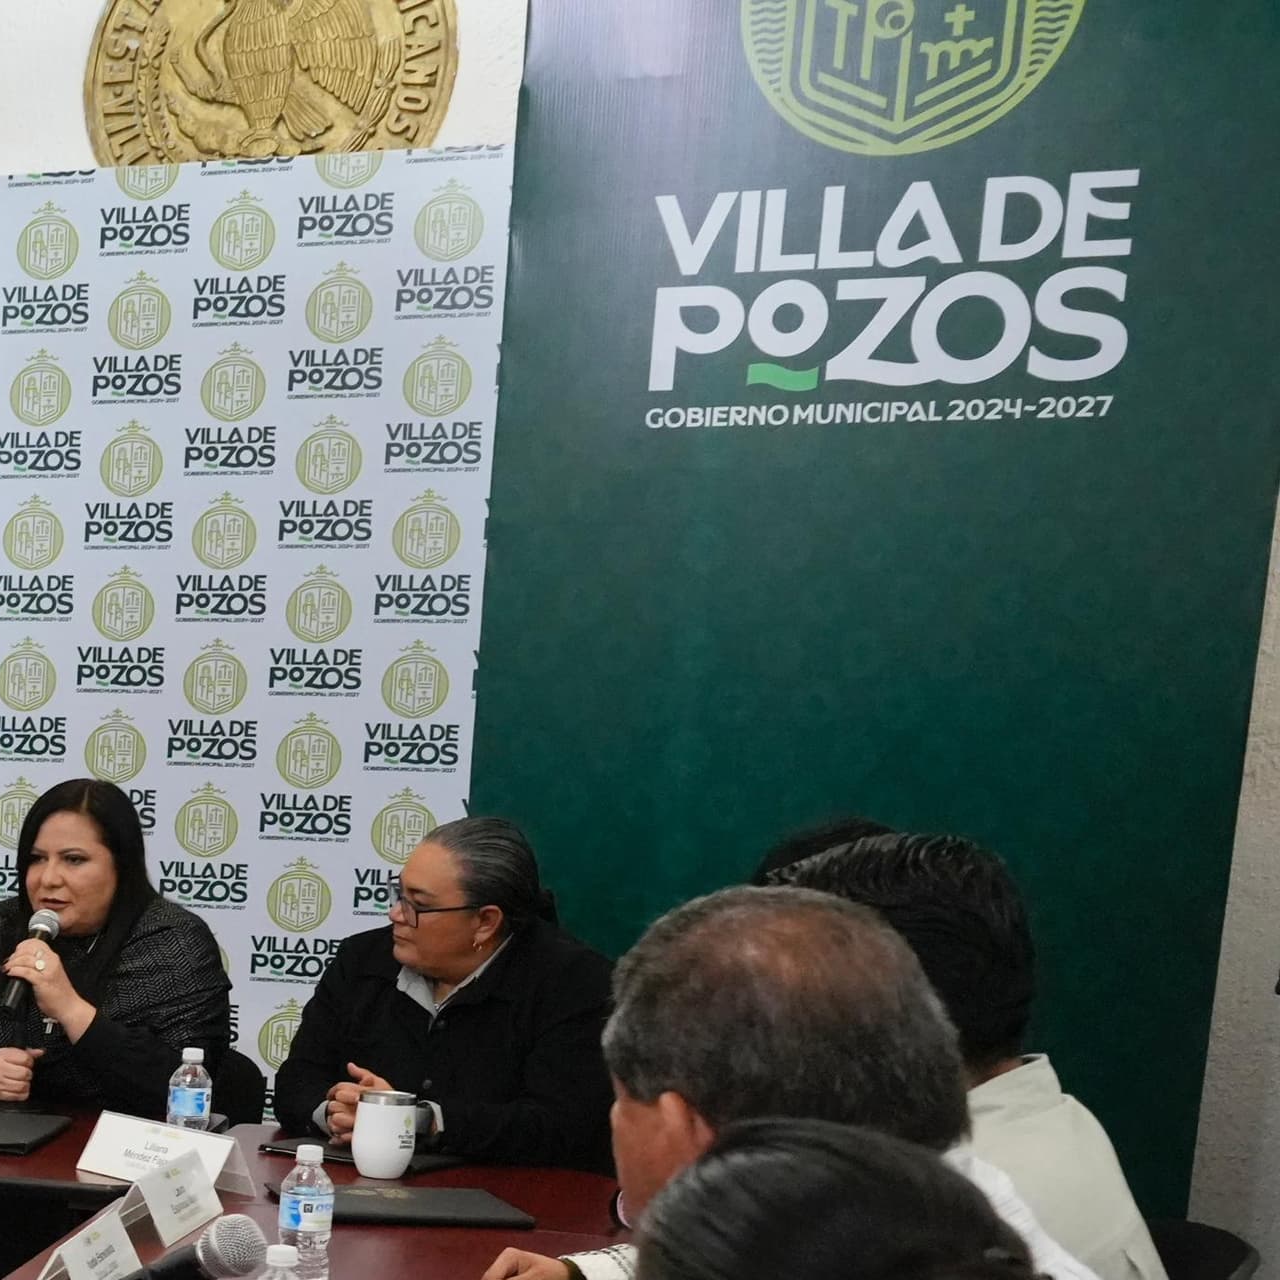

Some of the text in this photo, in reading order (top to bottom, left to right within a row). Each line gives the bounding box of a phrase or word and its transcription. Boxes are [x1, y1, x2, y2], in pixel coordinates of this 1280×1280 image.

[300, 193, 393, 213] VILLA DE
[101, 204, 190, 224] VILLA DE
[655, 169, 1140, 275] VILLA DE
[194, 275, 285, 295] VILLA DE
[398, 267, 492, 286] VILLA DE
[3, 284, 89, 303] VILLA DE
[93, 355, 181, 373] VILLA DE
[289, 348, 382, 367] VILLA DE
[645, 405, 790, 429] GOBIERNO
[792, 401, 943, 424] MUNICIPAL
[55, 431, 81, 447] DE
[185, 427, 276, 444] VILLA DE
[386, 422, 482, 440] VILLA DE
[85, 502, 173, 519] VILLA DE
[280, 500, 372, 517] VILLA DE
[47, 575, 73, 591] DE
[177, 575, 267, 591] VILLA DE
[376, 575, 471, 591] VILLA DE
[78, 647, 164, 663] VILLA DE
[270, 648, 362, 666] VILLA DE
[40, 717, 66, 733] DE
[168, 719, 257, 737] VILLA DE
[365, 723, 459, 741] VILLA DE
[129, 789, 156, 806] DE
[261, 793, 352, 812] VILLA DE
[160, 861, 248, 880] VILLA DE
[251, 936, 310, 954] VILLA
